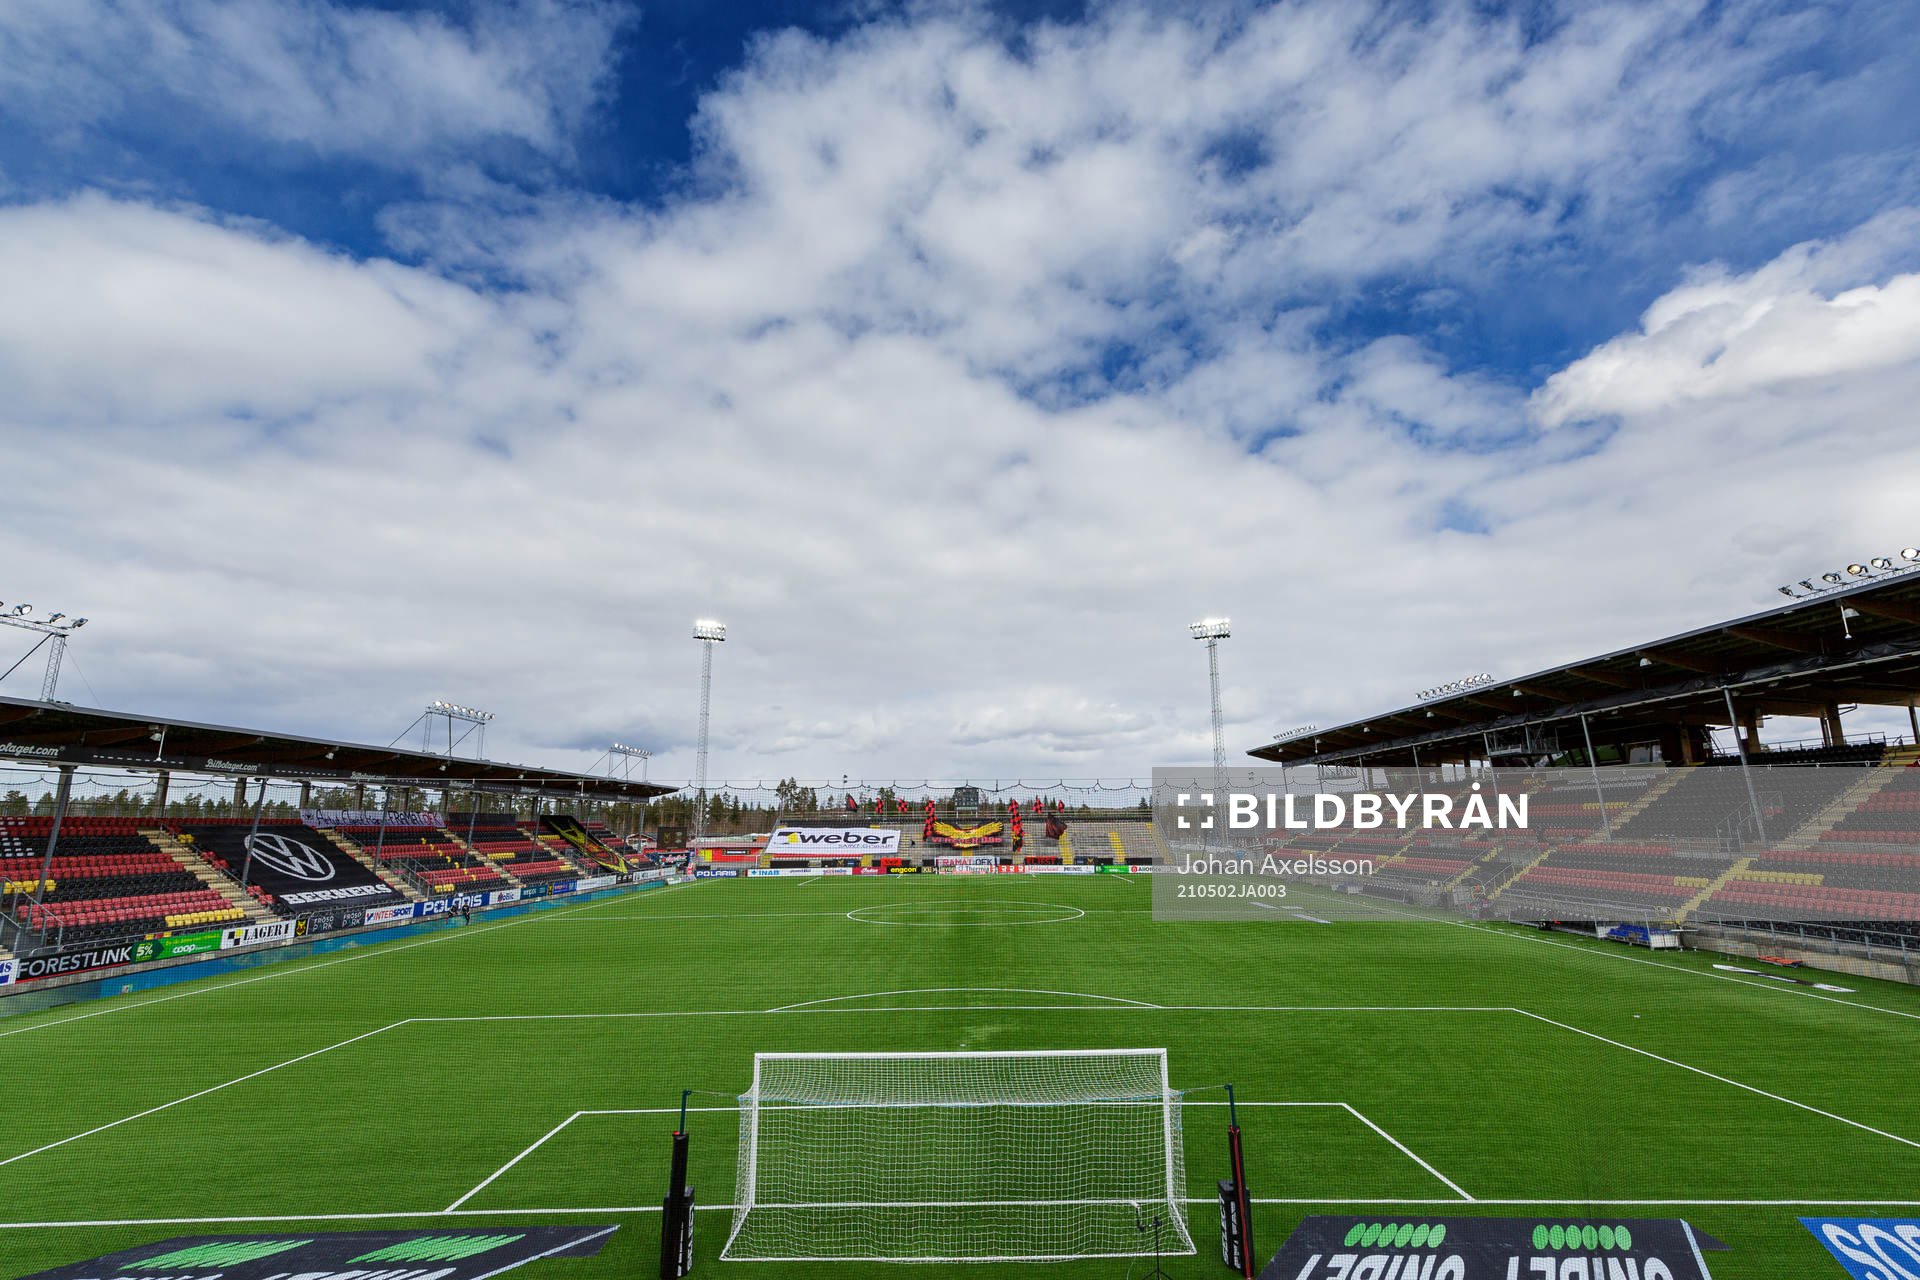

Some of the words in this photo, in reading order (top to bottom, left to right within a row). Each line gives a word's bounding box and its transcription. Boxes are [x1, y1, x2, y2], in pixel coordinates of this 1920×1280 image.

[800, 832, 895, 844] weber
[280, 884, 392, 905] BERNERS
[423, 894, 482, 916] POLARIS
[373, 906, 413, 920] INTERSPORT
[136, 944, 153, 957] 5%
[172, 943, 196, 954] coop
[17, 946, 132, 978] FORESTLINK
